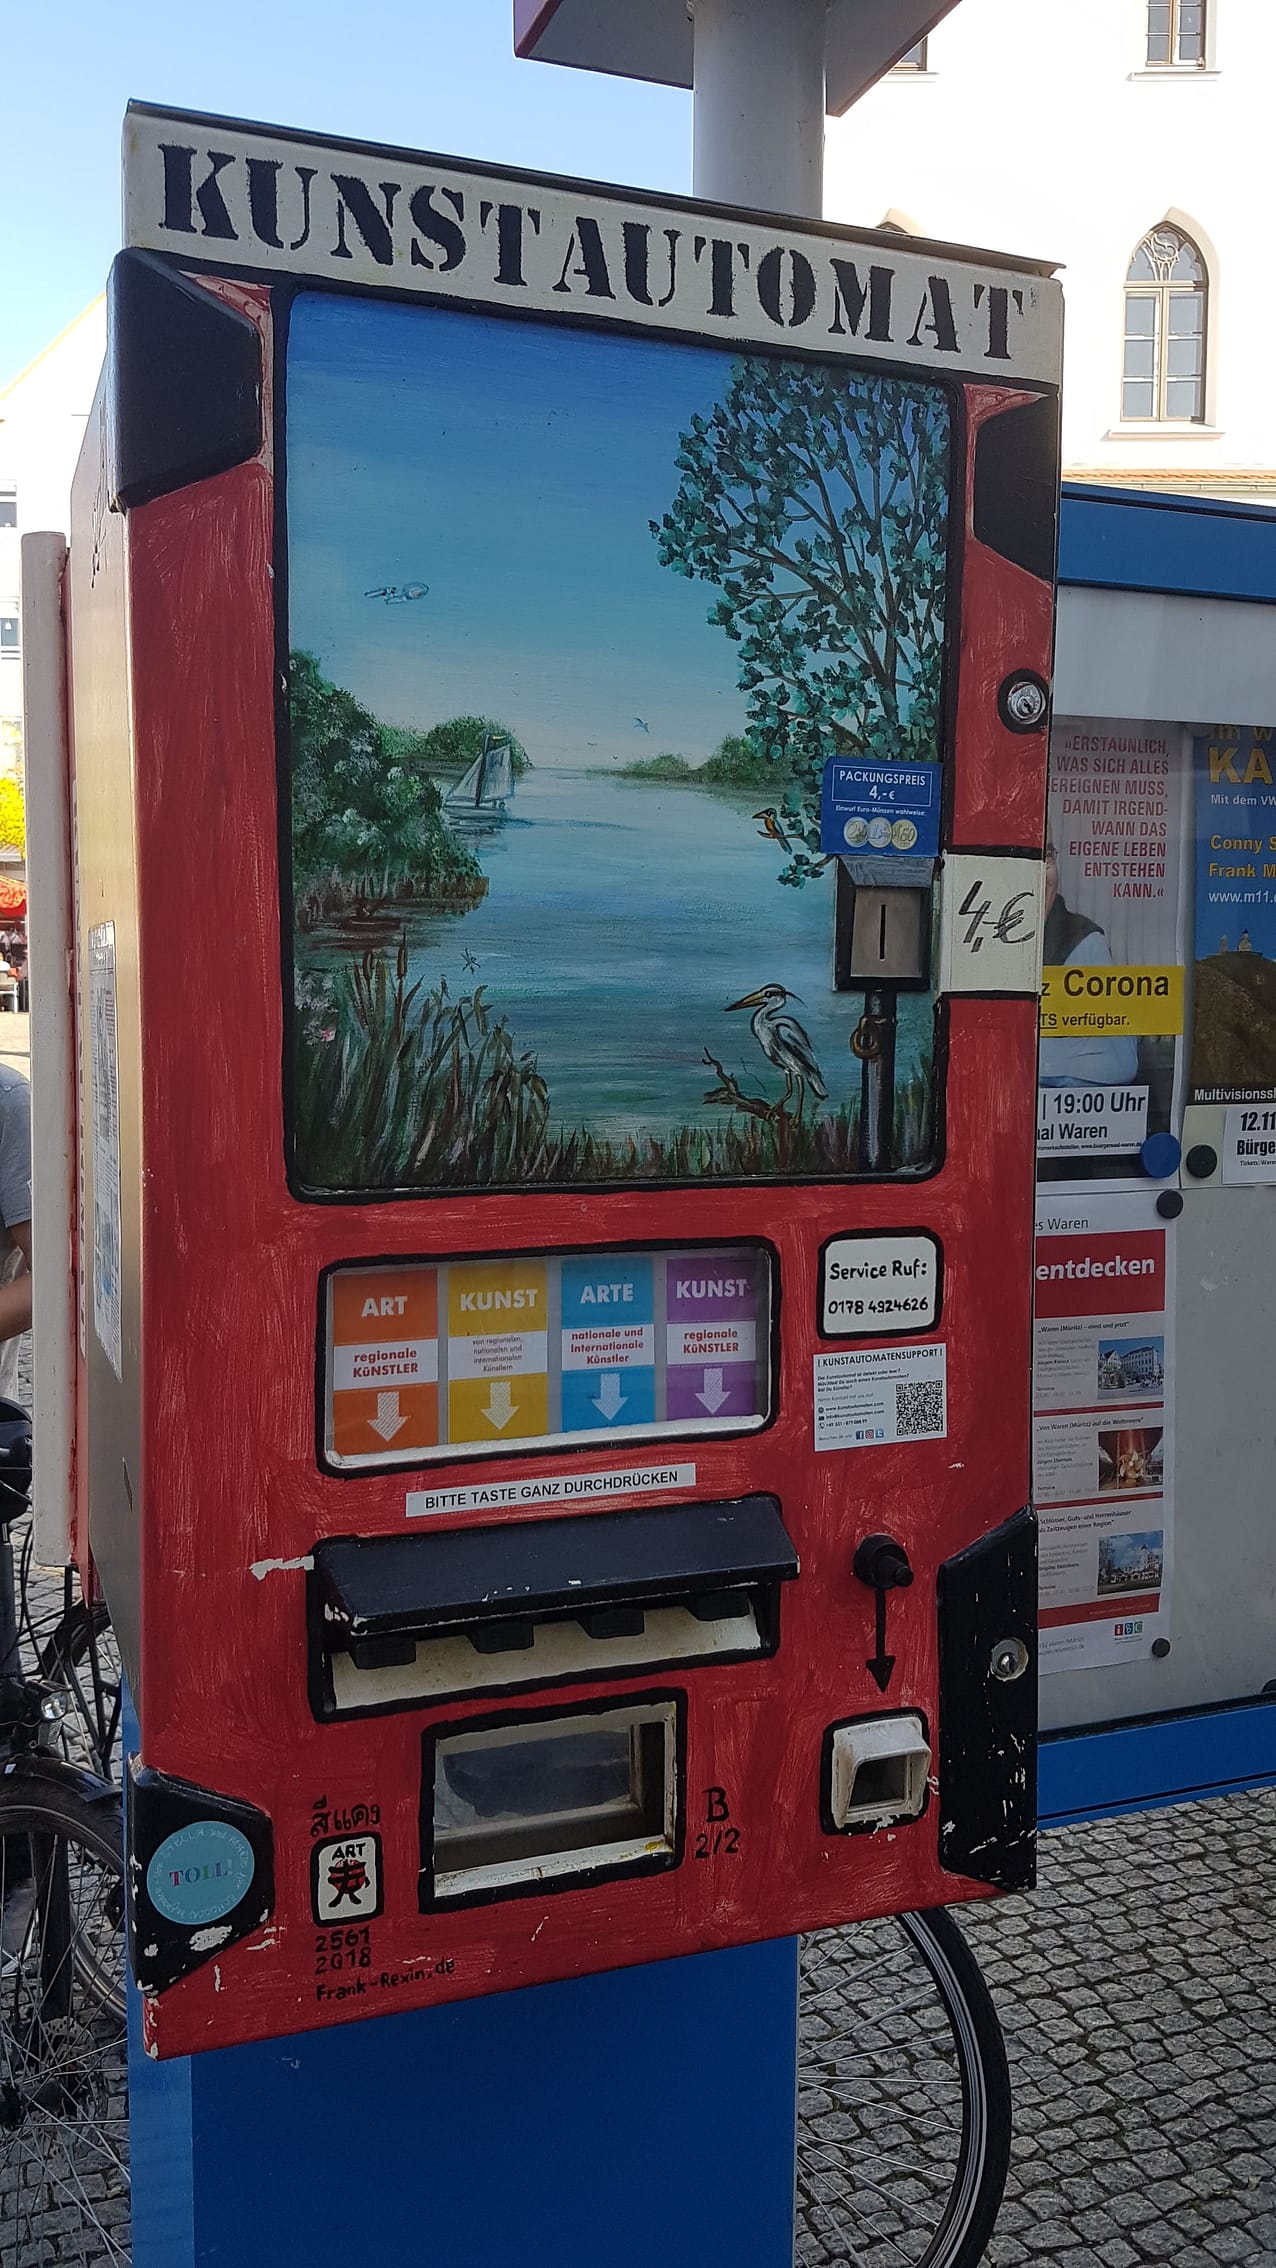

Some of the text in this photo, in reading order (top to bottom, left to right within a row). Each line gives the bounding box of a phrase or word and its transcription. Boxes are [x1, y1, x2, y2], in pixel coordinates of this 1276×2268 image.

[157, 143, 1024, 361] KUNSTAUTOMAT
[1057, 757, 1169, 775] WAS SICH ALLES
[839, 770, 926, 786] PACKUNGSPREIS
[1051, 778, 1168, 798] EREIGNEN MUSS,
[1063, 799, 1168, 816] DAMIT IRGEND-
[1210, 794, 1229, 804] Mit
[1233, 795, 1257, 805] dem
[1091, 821, 1167, 837] WANN DAS
[1069, 842, 1166, 857] EIGENE LEBEN
[1210, 835, 1262, 854] Conny
[1084, 862, 1165, 877] ENTSTEHEN
[1209, 863, 1256, 878] Frank
[1208, 890, 1276, 904] www.m11.
[1063, 969, 1169, 997] Corona
[1062, 1013, 1130, 1028] verfügbar.
[1054, 1092, 1147, 1114] 19:00 Uhr
[1059, 1123, 1107, 1139] Waren
[1047, 1218, 1089, 1230] Waren
[829, 1258, 927, 1280] Service Ruf:
[1035, 1255, 1155, 1281] entdecken
[580, 1283, 634, 1304] ARTE
[676, 1279, 747, 1299] KUNST
[361, 1296, 408, 1317] ART
[460, 1289, 538, 1312] KUNST
[828, 1296, 929, 1315] 0178 4924626
[571, 1327, 643, 1340] nationale und
[684, 1328, 738, 1341] regionale
[354, 1349, 417, 1364] regionale
[586, 1354, 630, 1365] Künstler
[822, 1348, 938, 1367] KUNSTAUTOMATENSUPPORT
[425, 1470, 678, 1509] BITTE TASTE GANZ DURCHDRÜCKEN
[702, 1786, 730, 1822] B
[332, 1842, 368, 1860] ART
[695, 1828, 741, 1859] 2/2
[315, 1926, 370, 1951] 2561
[315, 1947, 372, 1975] 2018
